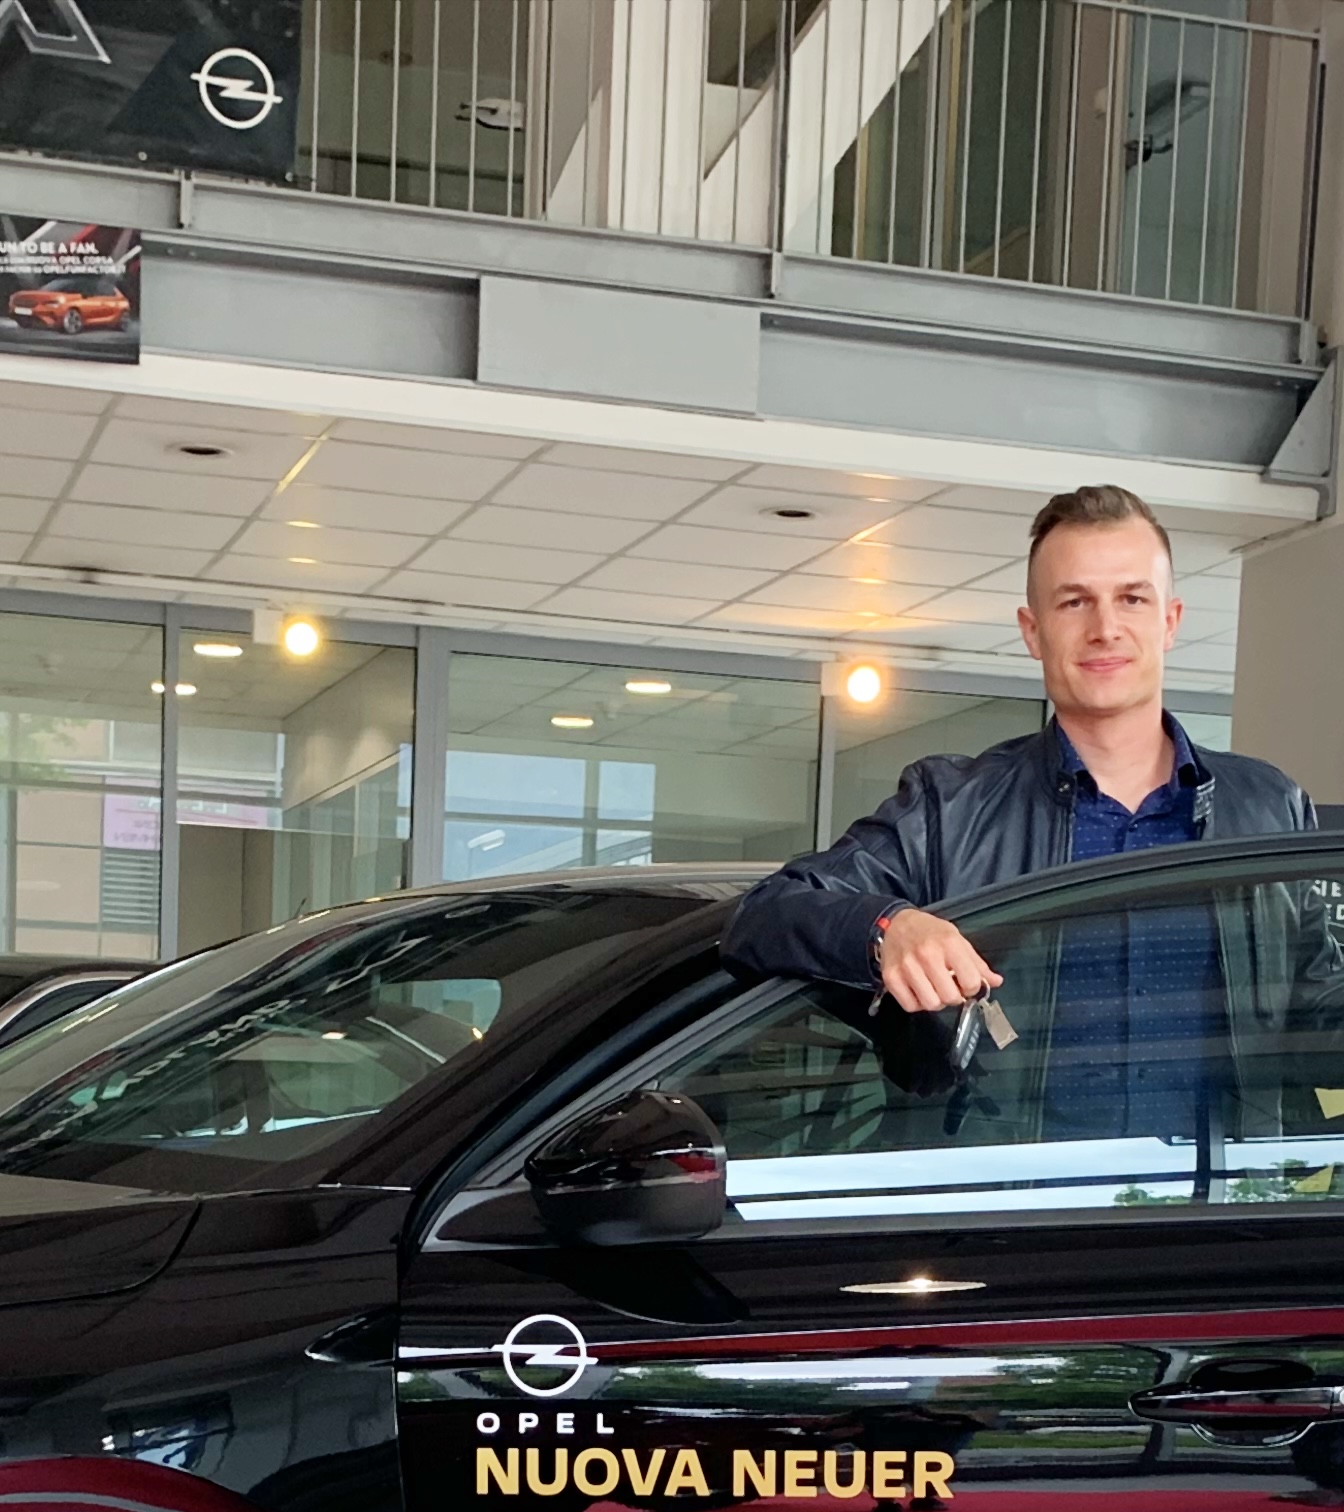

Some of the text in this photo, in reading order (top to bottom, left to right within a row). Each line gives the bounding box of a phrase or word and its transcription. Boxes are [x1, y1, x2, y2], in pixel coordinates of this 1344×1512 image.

[476, 1412, 615, 1434] OPEL
[476, 1447, 955, 1499] NUOVA NEUER
